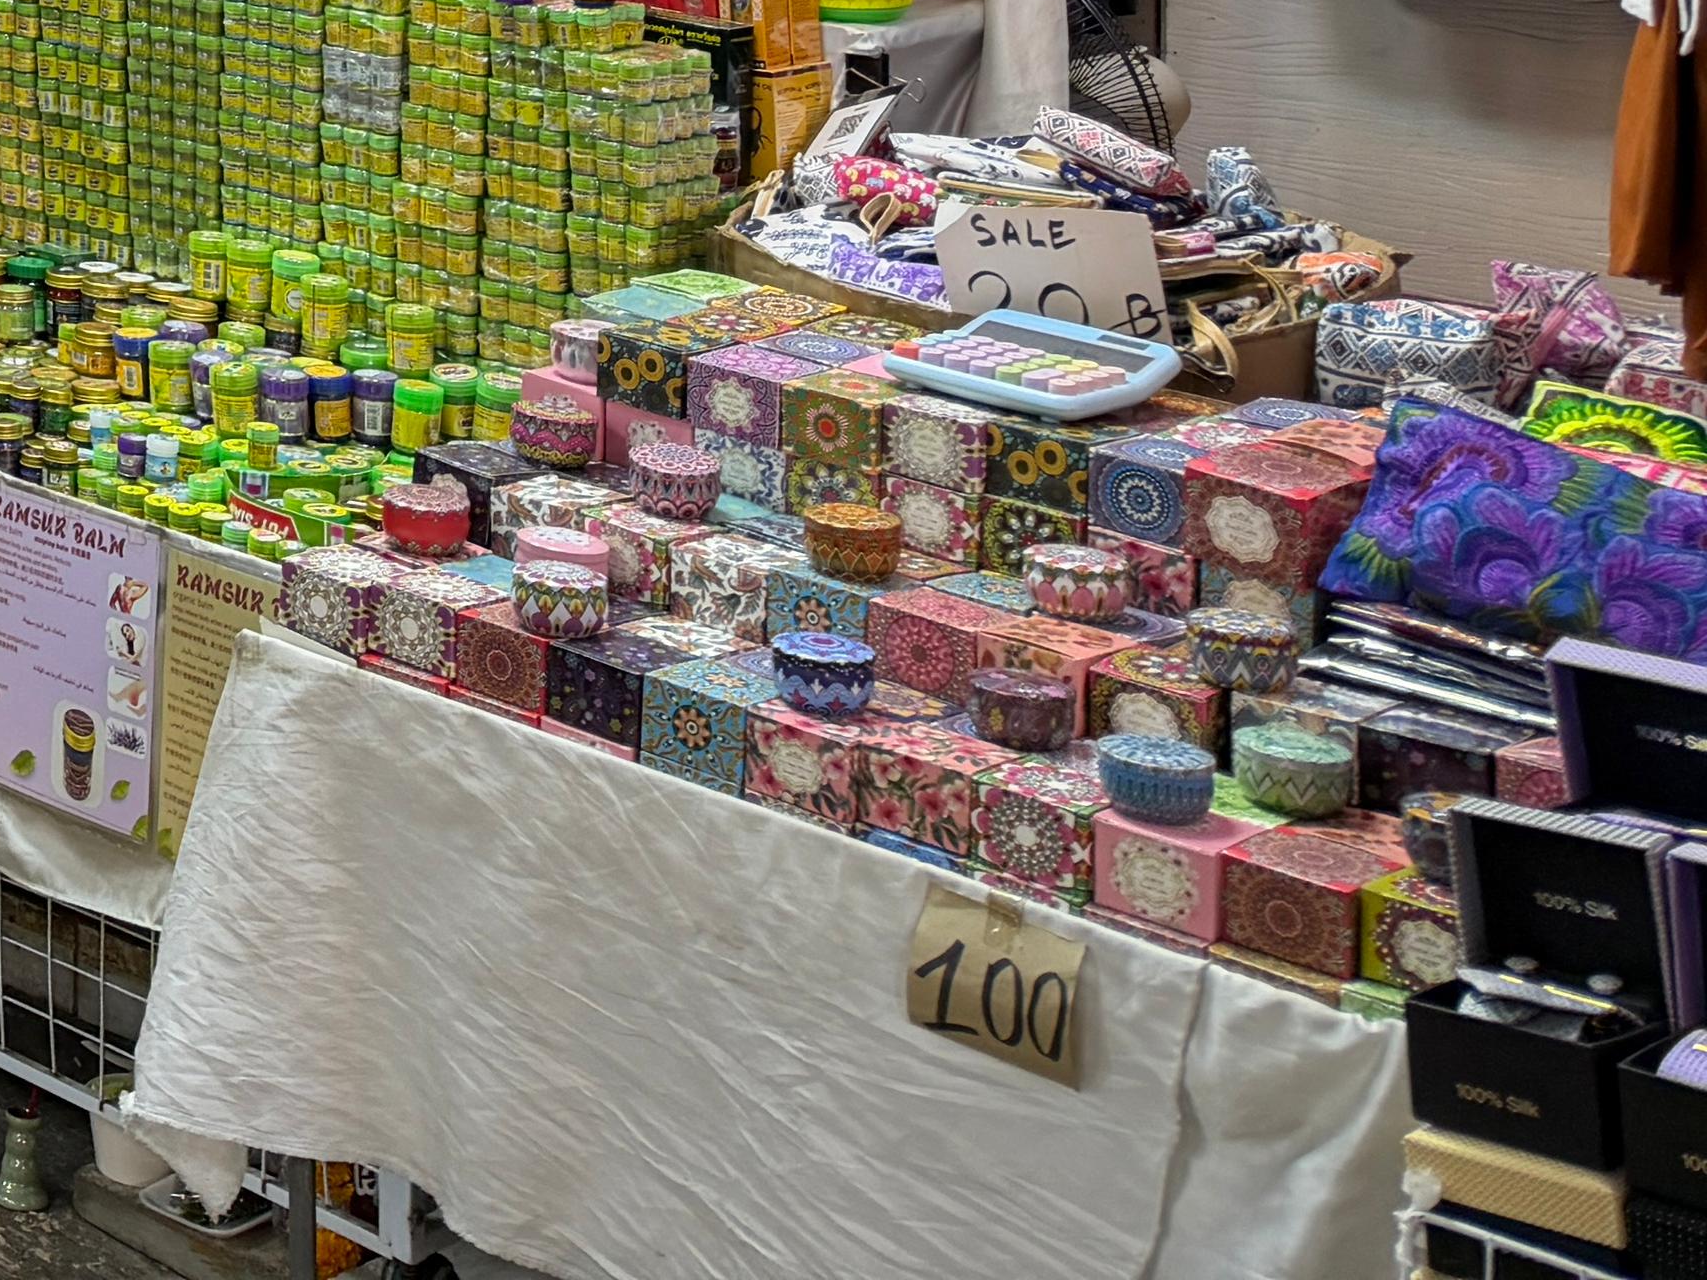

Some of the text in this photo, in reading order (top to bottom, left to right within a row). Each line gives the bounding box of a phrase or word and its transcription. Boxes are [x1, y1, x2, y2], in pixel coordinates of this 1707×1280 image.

[970, 213, 1076, 250] SALE
[72, 521, 128, 559] BALM
[176, 563, 265, 616] RAMSUR
[1533, 890, 1619, 921] 100% Silk
[914, 938, 1068, 1063] 100
[1455, 1082, 1540, 1120] 100% Silk
